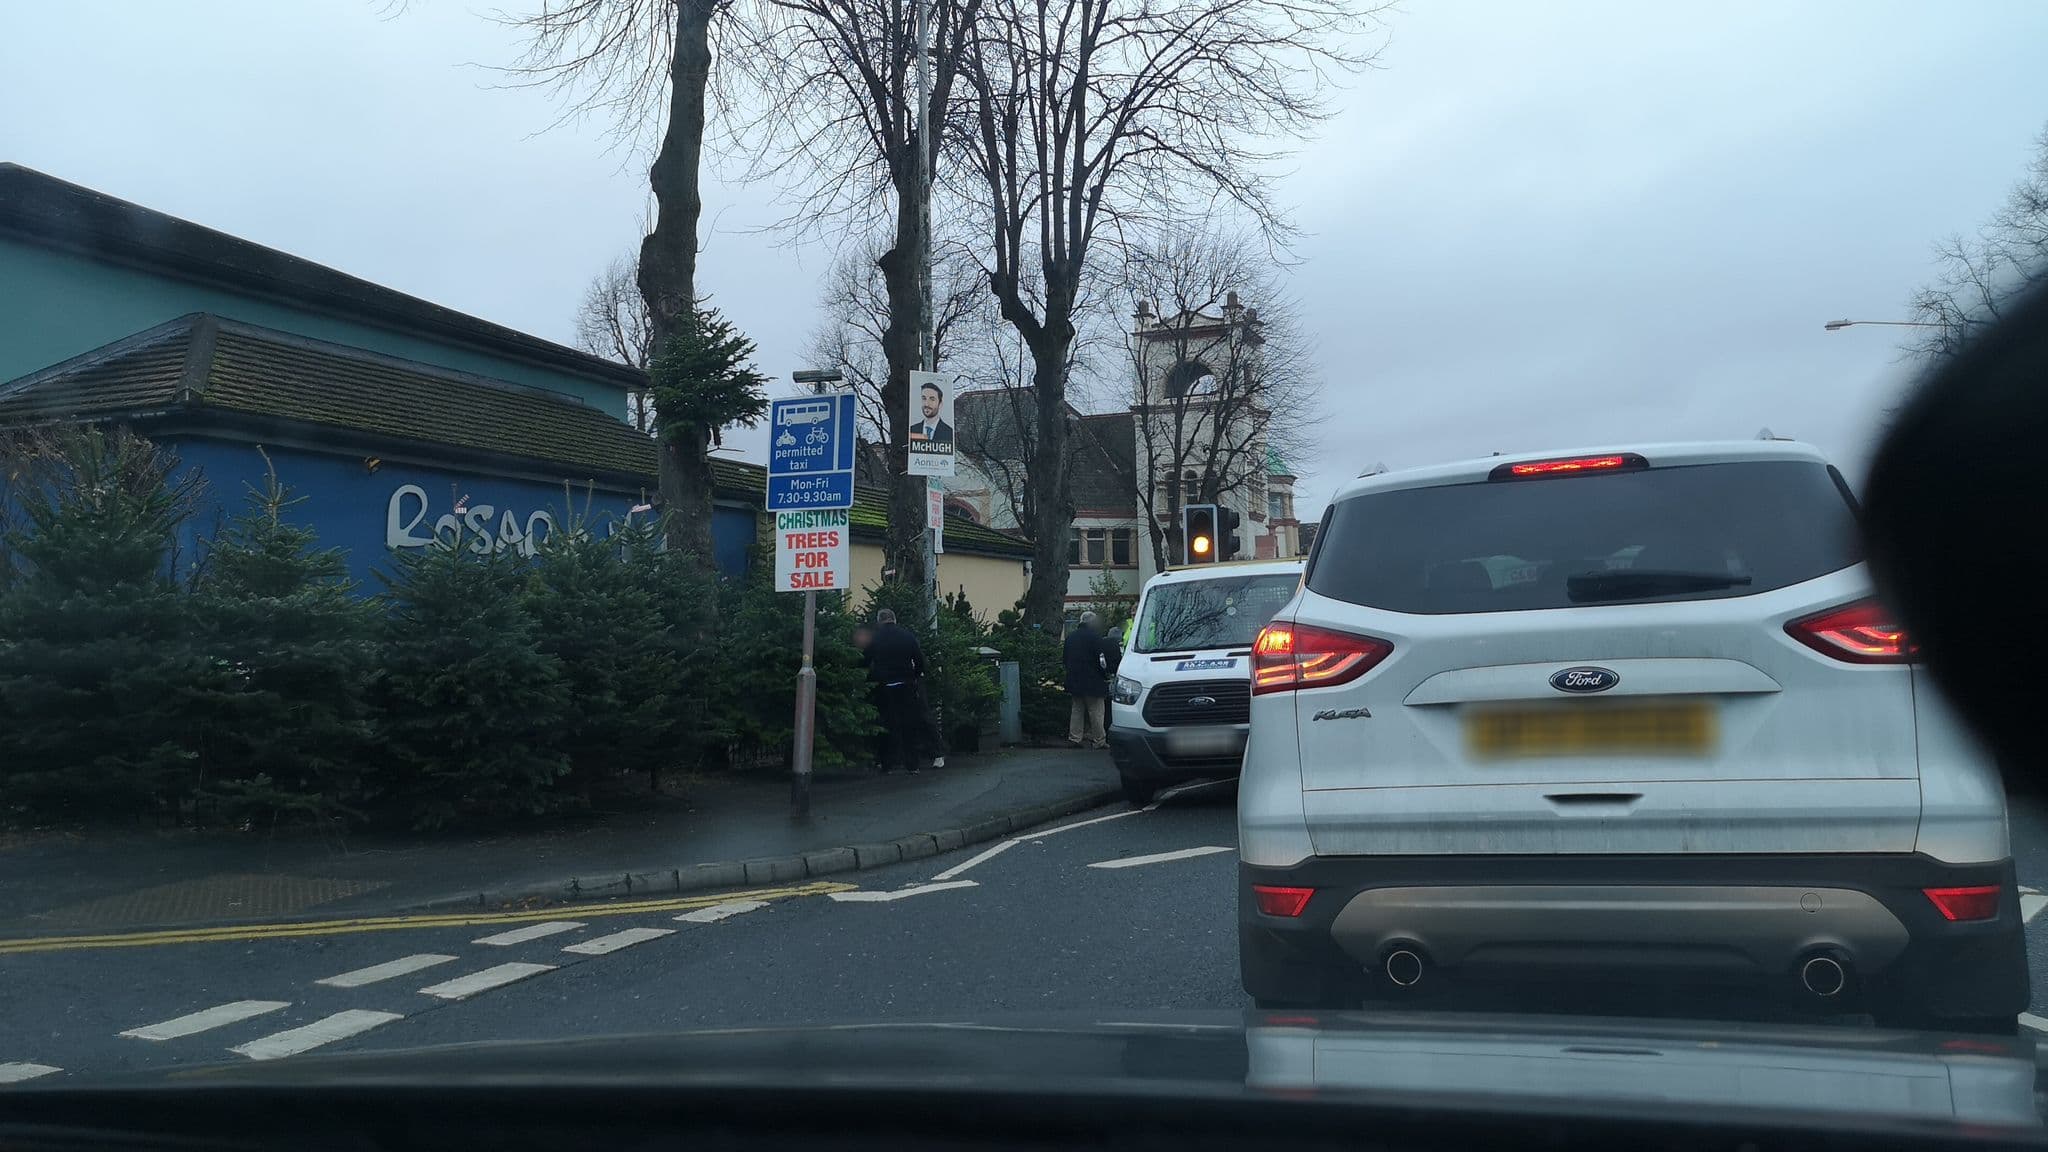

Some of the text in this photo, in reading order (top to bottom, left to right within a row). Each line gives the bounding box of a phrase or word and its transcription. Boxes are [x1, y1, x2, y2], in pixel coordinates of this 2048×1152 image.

[775, 445, 823, 460] permitted
[912, 441, 951, 453] McHUGH
[789, 460, 808, 470] taxi
[791, 478, 829, 490] Mon-Fri
[777, 491, 842, 504] 7.30-9.30am
[778, 510, 848, 530] CHRISTMAS
[786, 531, 839, 549] TREES
[795, 551, 829, 569] FOR
[790, 571, 834, 589] SALE
[1564, 671, 1602, 687] Ford
[1312, 706, 1372, 722] KUGA
